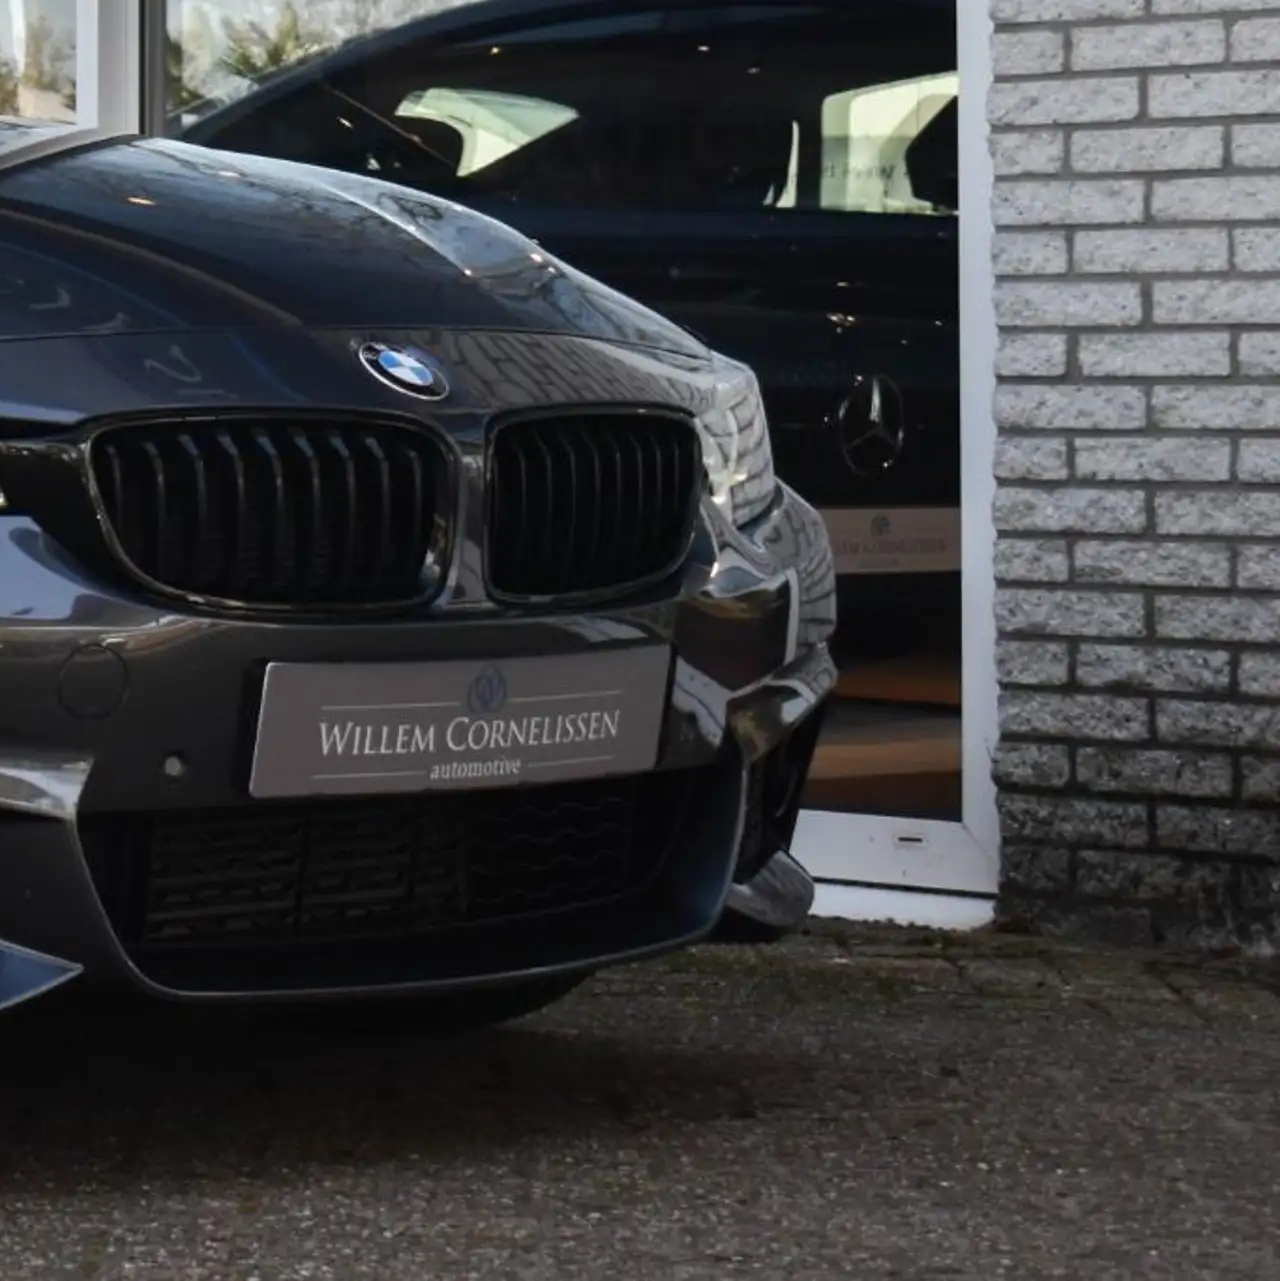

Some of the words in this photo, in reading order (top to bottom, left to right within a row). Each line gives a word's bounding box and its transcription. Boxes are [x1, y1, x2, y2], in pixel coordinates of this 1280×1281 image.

[320, 720, 436, 756] WILLEM
[446, 710, 620, 752] CORNELISSEN
[430, 757, 522, 781] automotive
